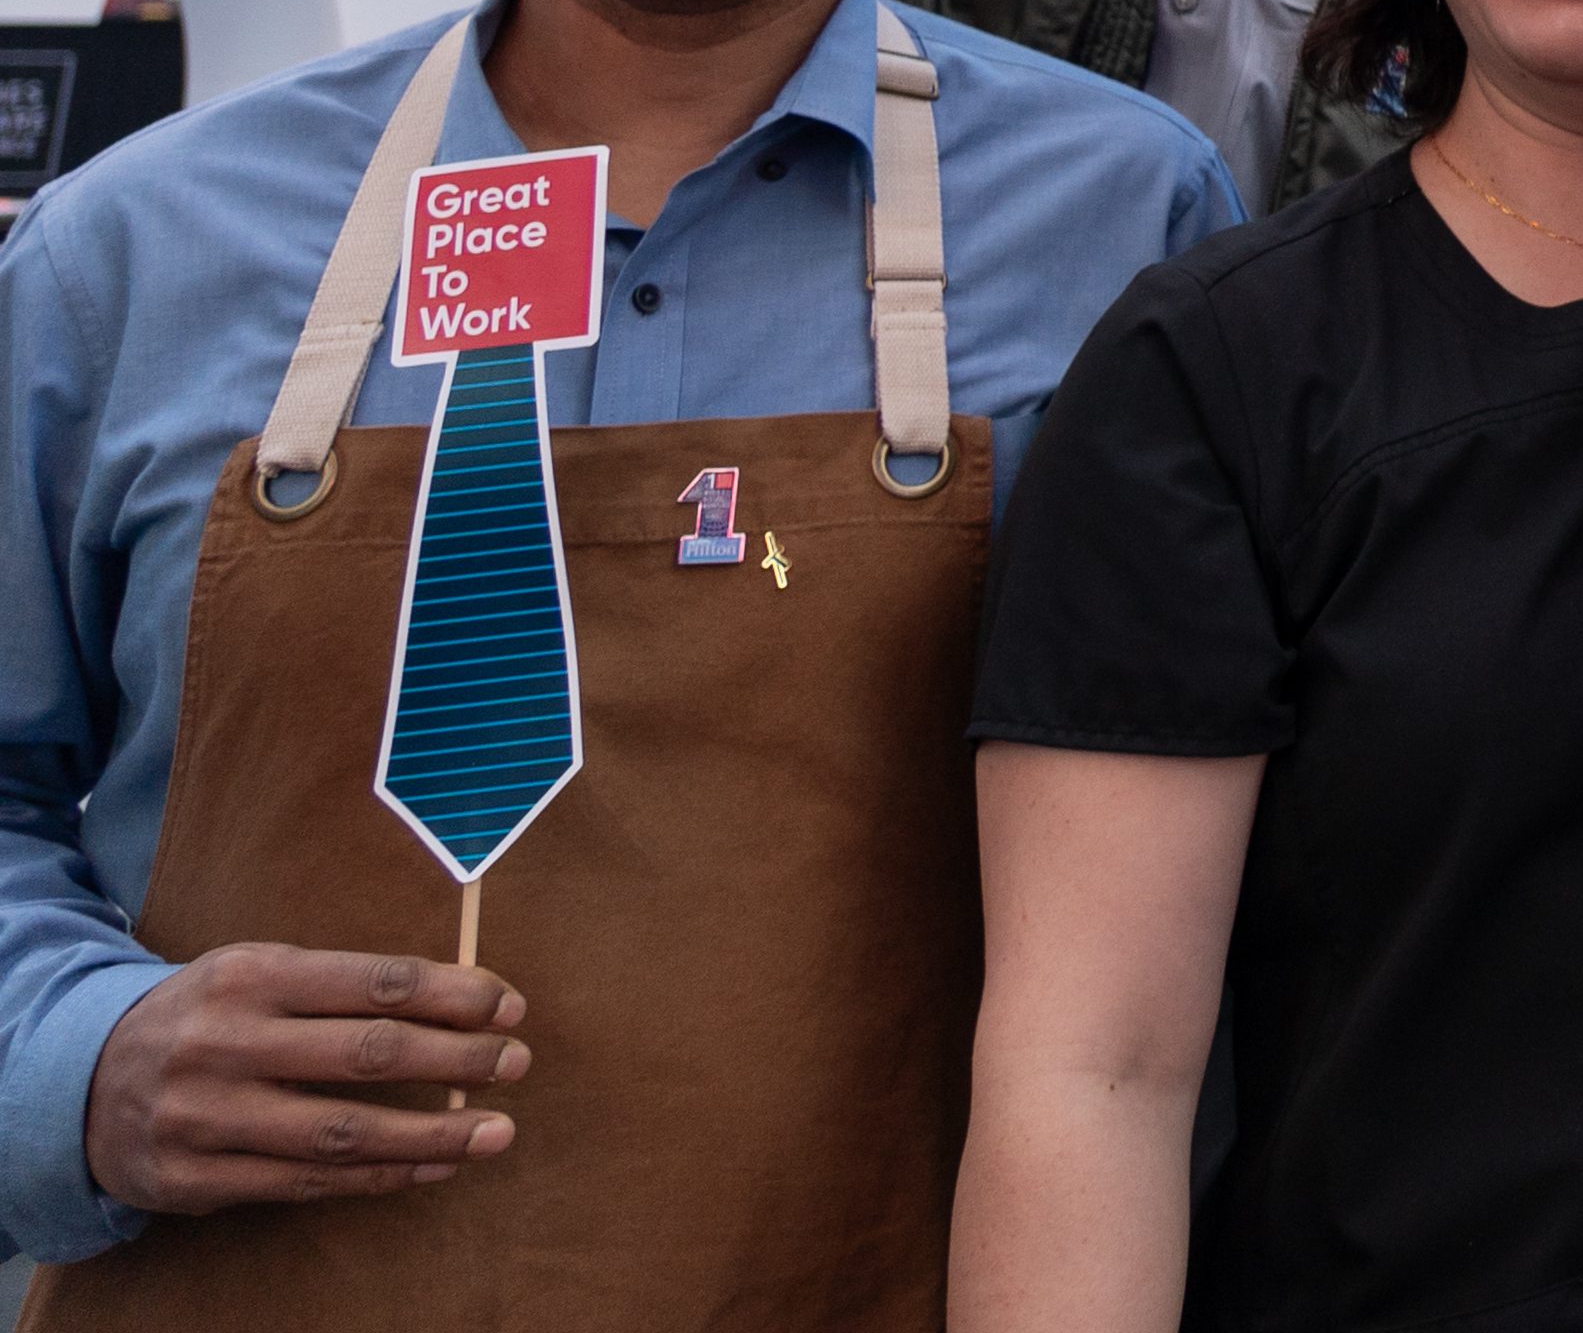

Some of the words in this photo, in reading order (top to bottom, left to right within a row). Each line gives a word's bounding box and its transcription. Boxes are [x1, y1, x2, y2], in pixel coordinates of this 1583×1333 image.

[426, 175, 550, 220] Great
[426, 217, 548, 259] Place
[420, 265, 469, 299] To
[418, 296, 532, 342] Work
[686, 537, 737, 558] Hilton
